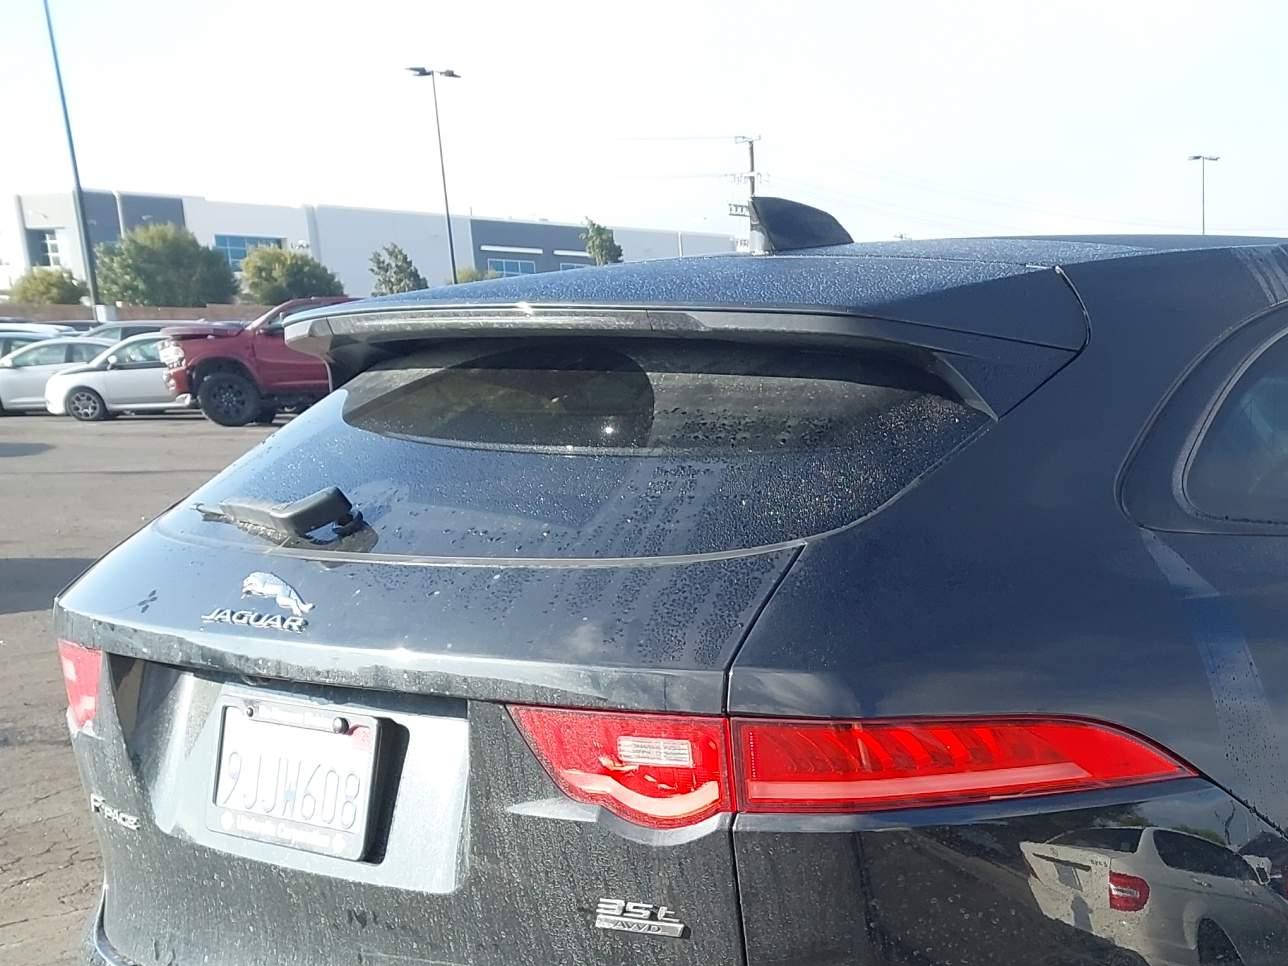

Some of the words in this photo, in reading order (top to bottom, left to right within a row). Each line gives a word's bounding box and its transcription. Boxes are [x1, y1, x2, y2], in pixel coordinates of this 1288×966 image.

[201, 607, 306, 633] JAGUAR
[223, 751, 361, 830] 9JJW608
[613, 920, 663, 934] AWD
